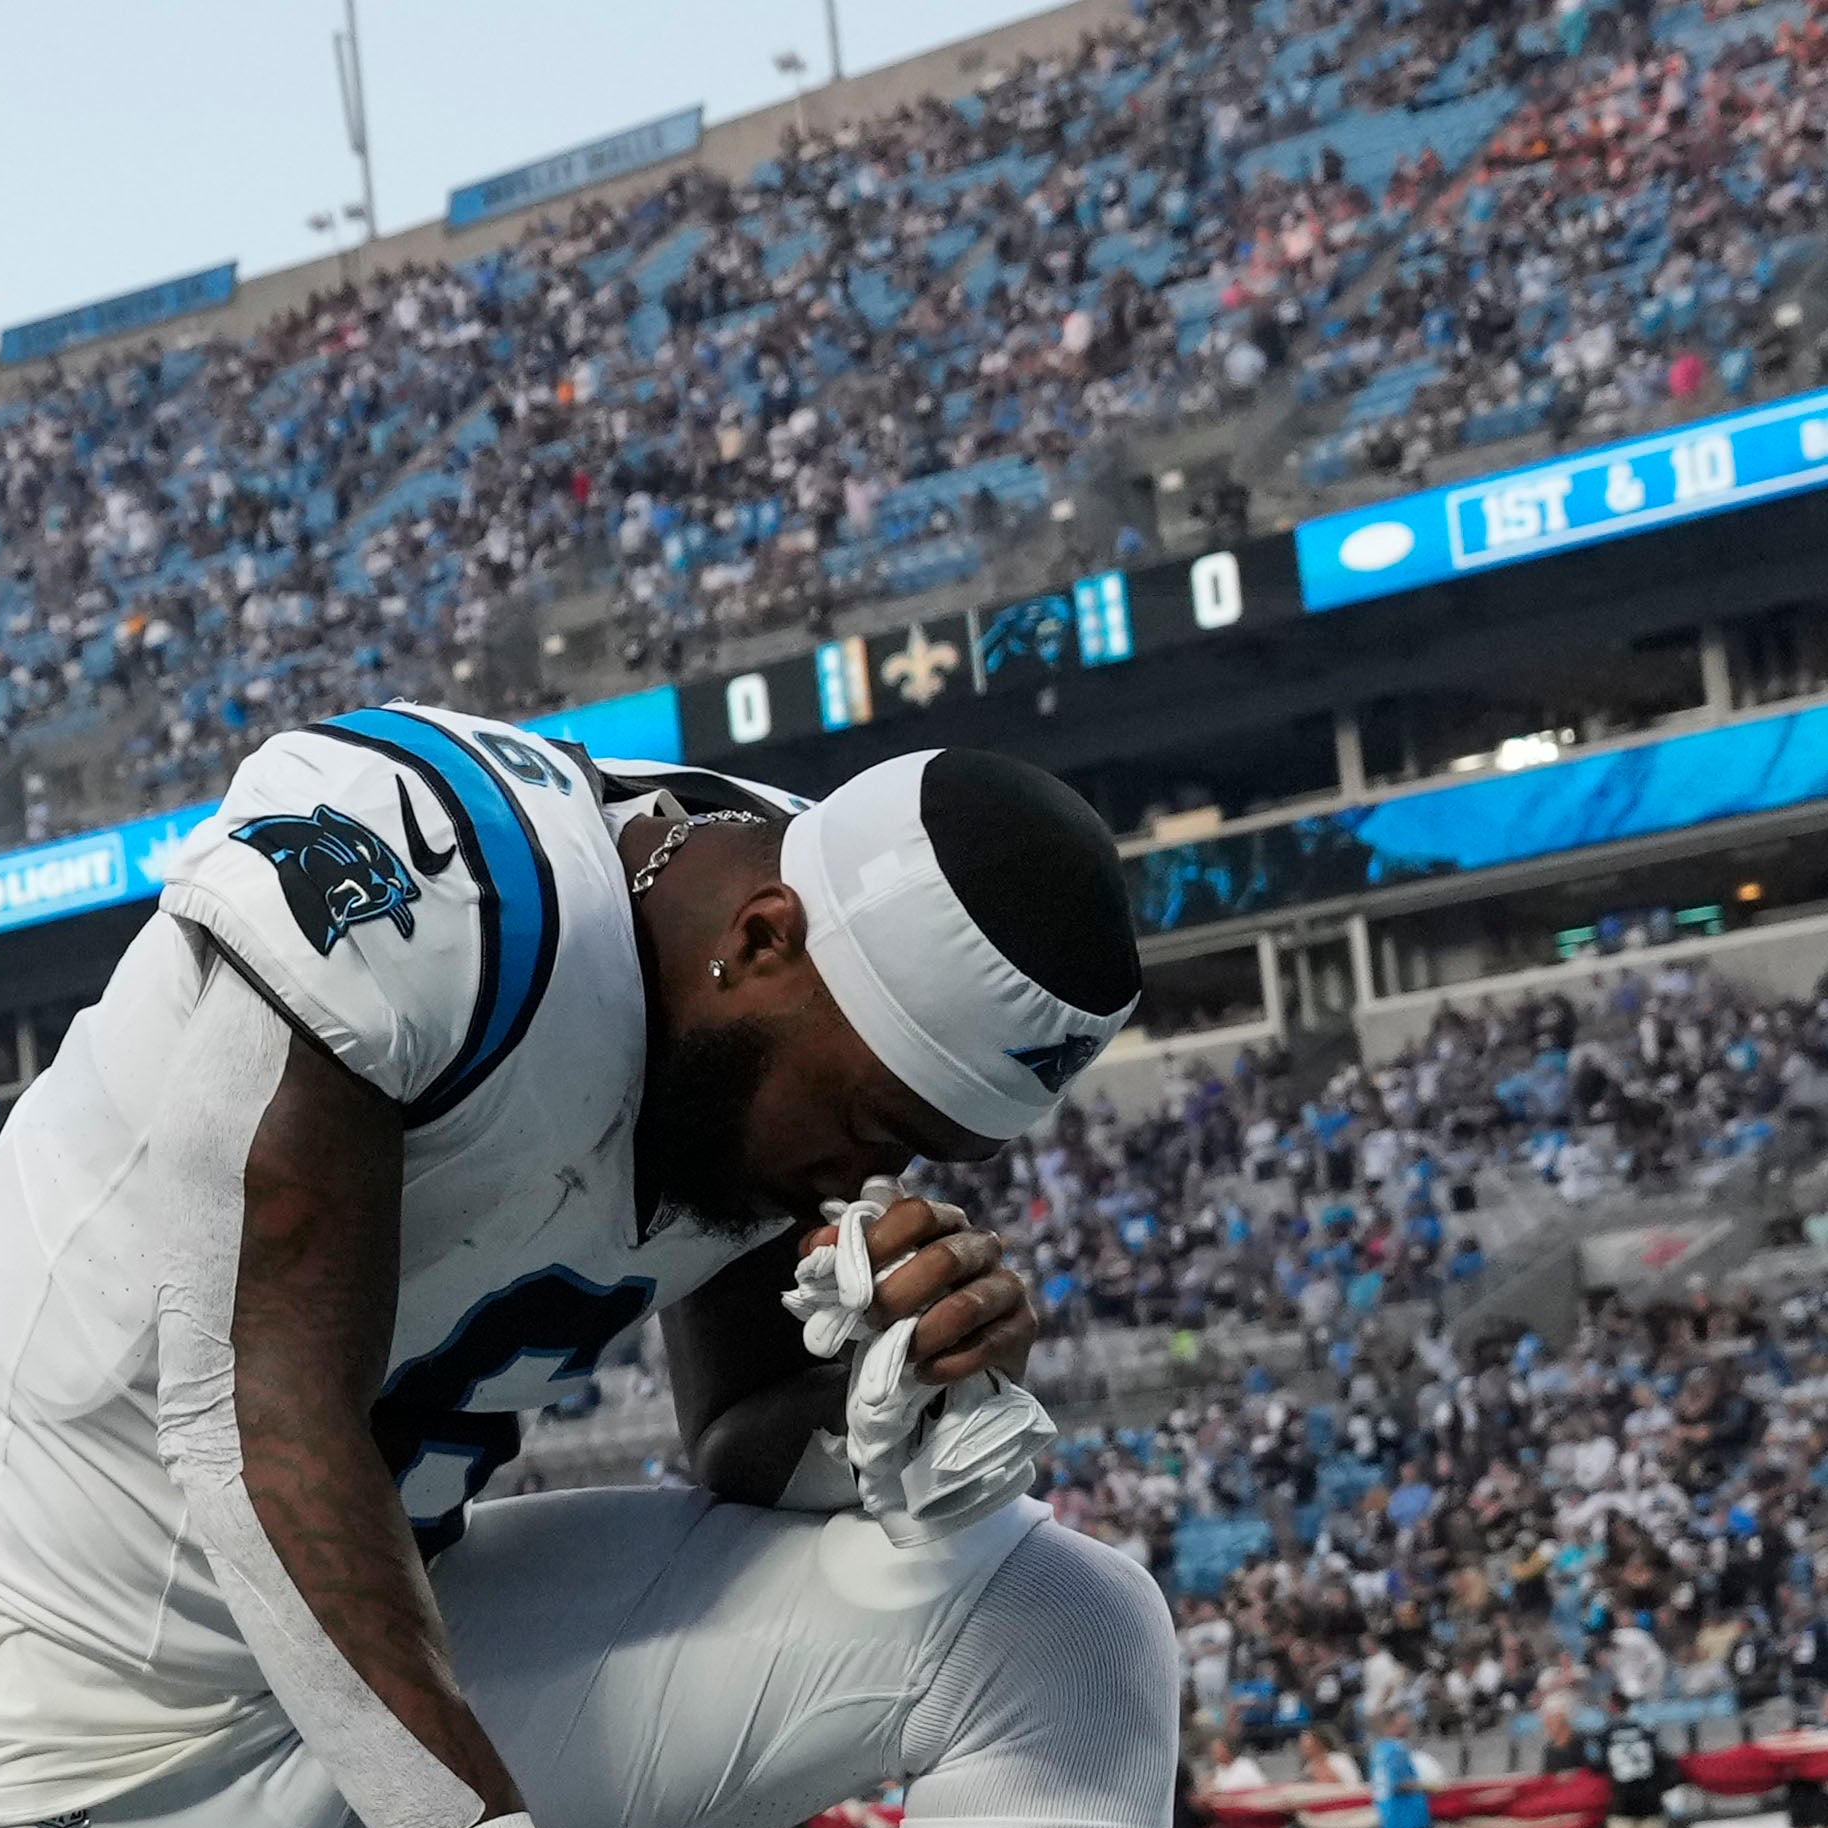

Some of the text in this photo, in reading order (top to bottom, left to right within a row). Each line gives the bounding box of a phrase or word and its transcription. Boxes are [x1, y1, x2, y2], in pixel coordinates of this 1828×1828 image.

[1481, 474, 1573, 548] 1ST
[1605, 459, 1645, 514] &
[1670, 432, 1736, 500] 10
[1190, 550, 1243, 630] 0
[726, 672, 771, 744] 0
[8, 848, 112, 900] LIGHT
